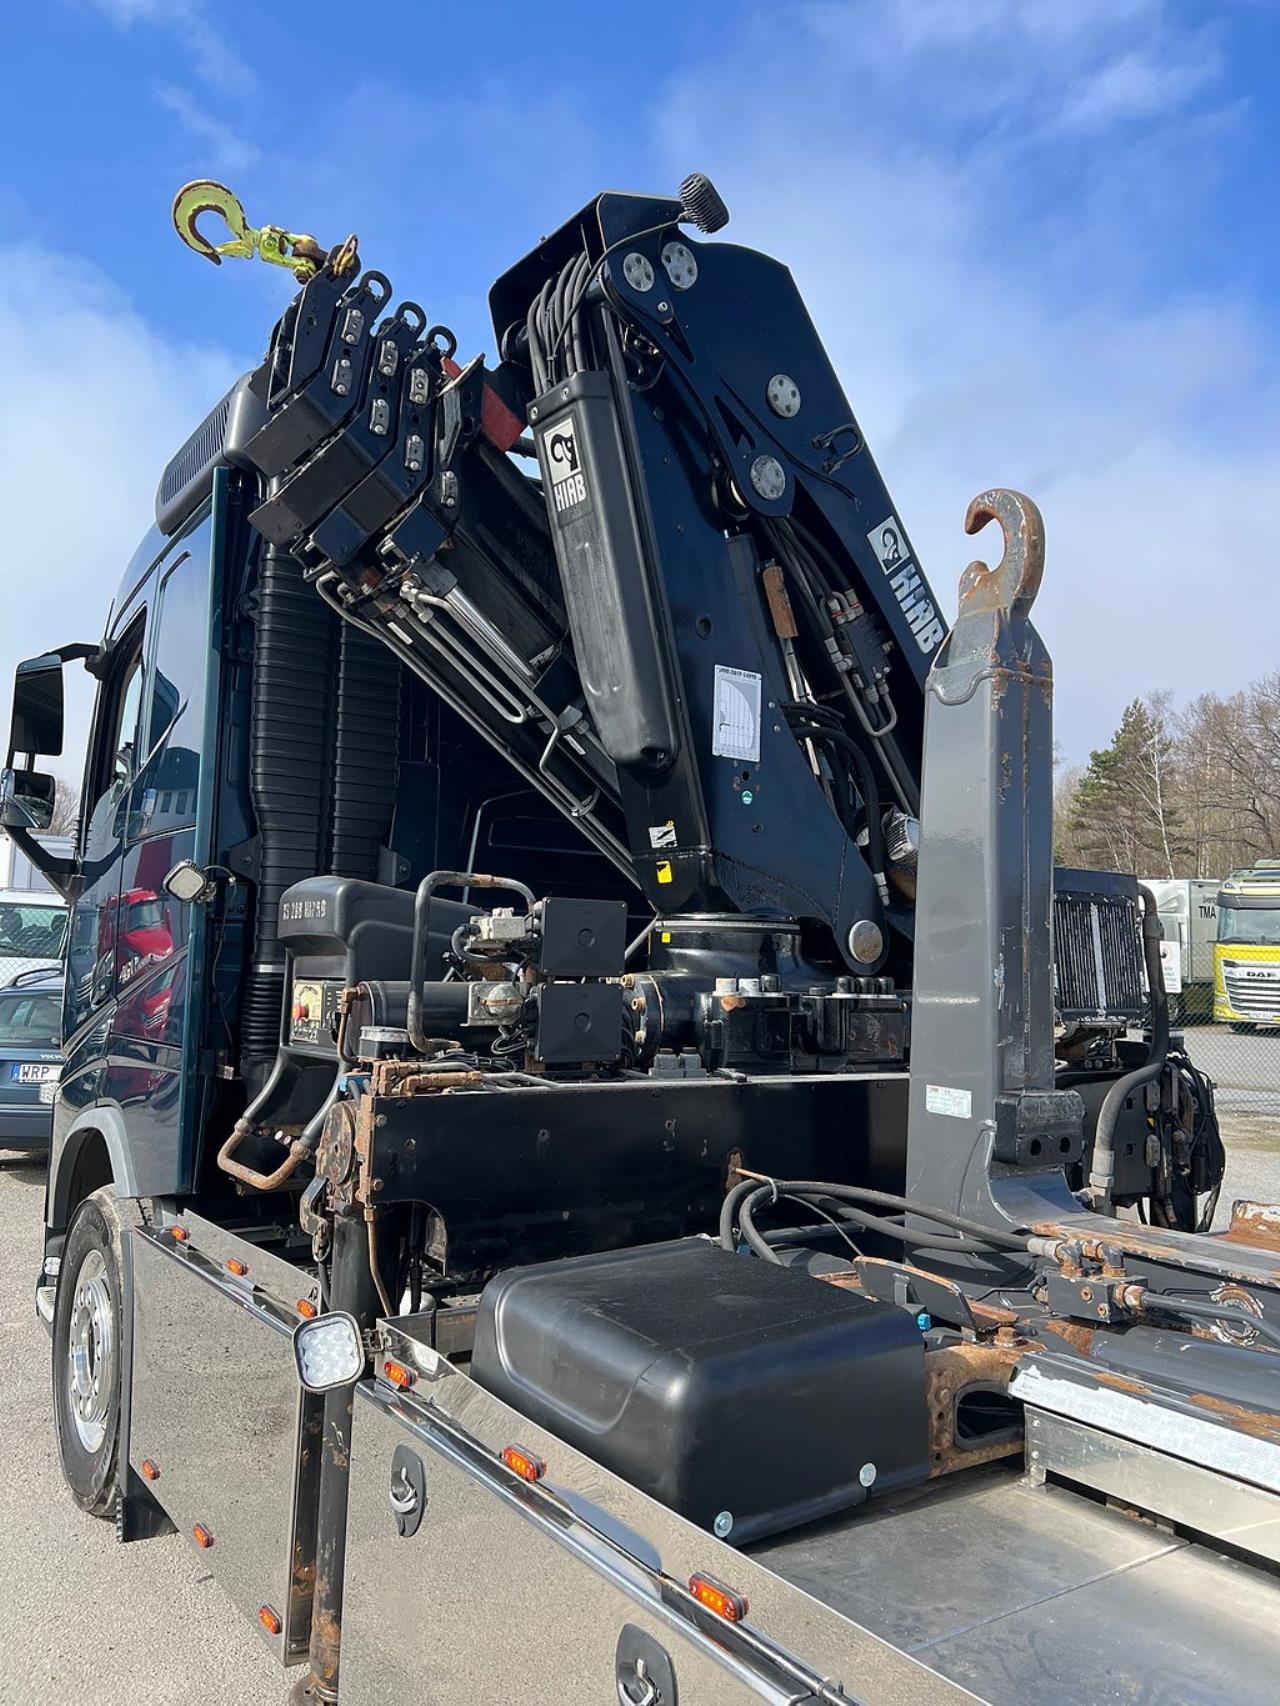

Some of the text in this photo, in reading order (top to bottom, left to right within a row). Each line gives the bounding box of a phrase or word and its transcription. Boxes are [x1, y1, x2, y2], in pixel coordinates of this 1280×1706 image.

[554, 474, 586, 512] HIAB
[889, 563, 945, 654] HIAB
[22, 1066, 50, 1078] WRP
